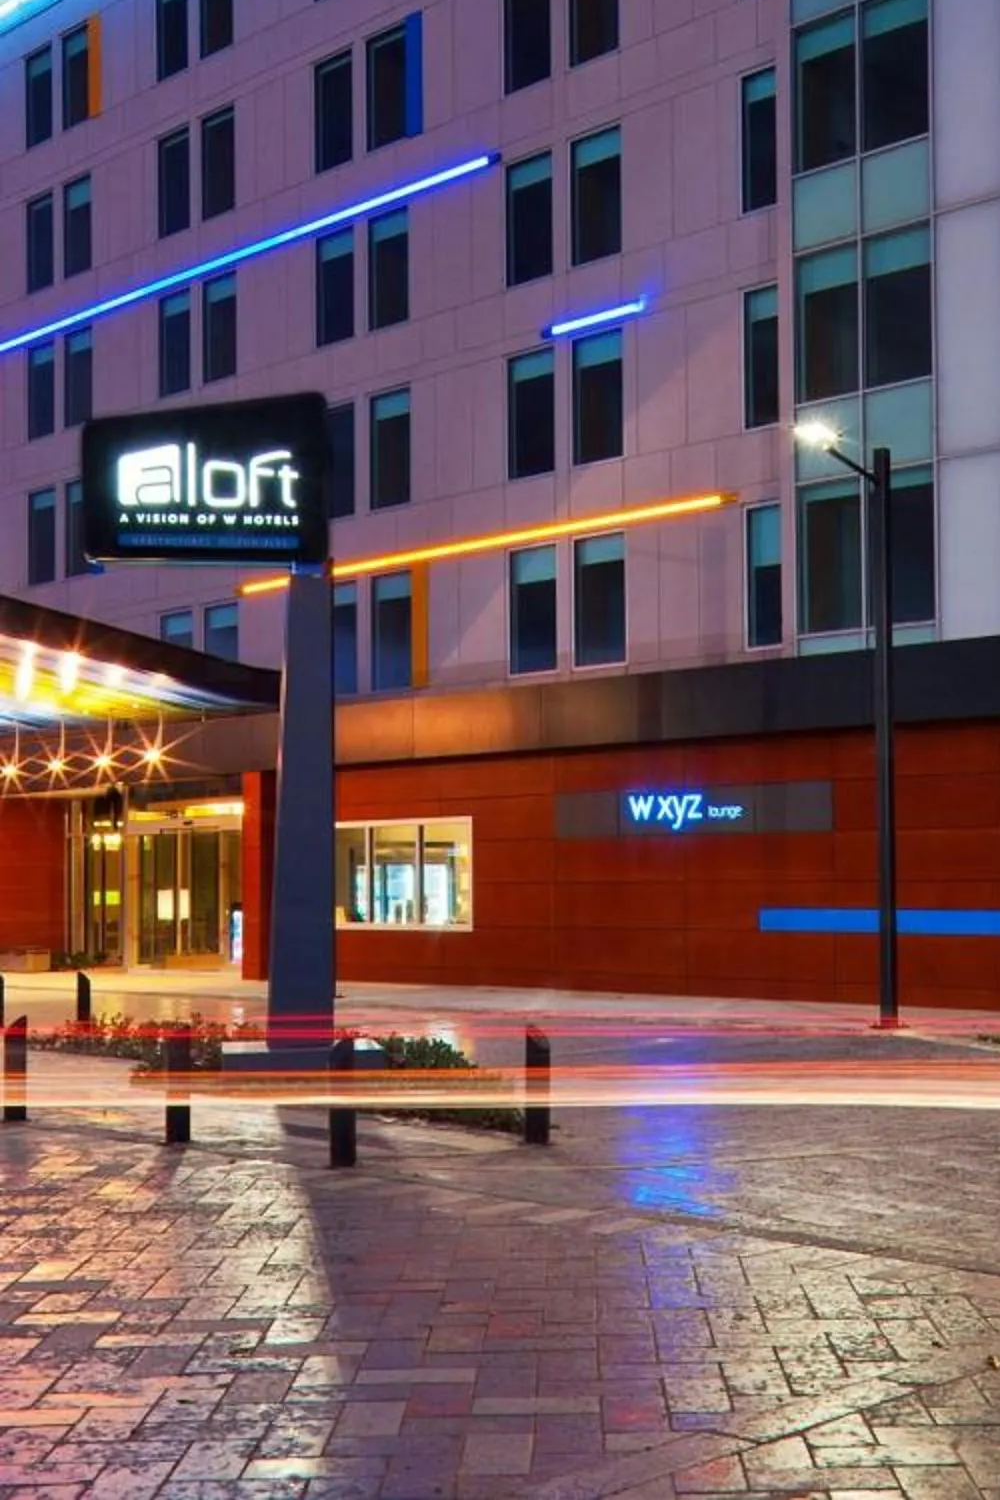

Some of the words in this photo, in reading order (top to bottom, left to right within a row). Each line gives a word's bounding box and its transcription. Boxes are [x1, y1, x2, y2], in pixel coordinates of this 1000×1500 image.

[117, 442, 299, 508] aloft
[119, 513, 129, 523] A
[136, 513, 189, 524] VISION
[196, 514, 216, 525] OF
[223, 514, 237, 525] W
[243, 514, 299, 526] HOTELS
